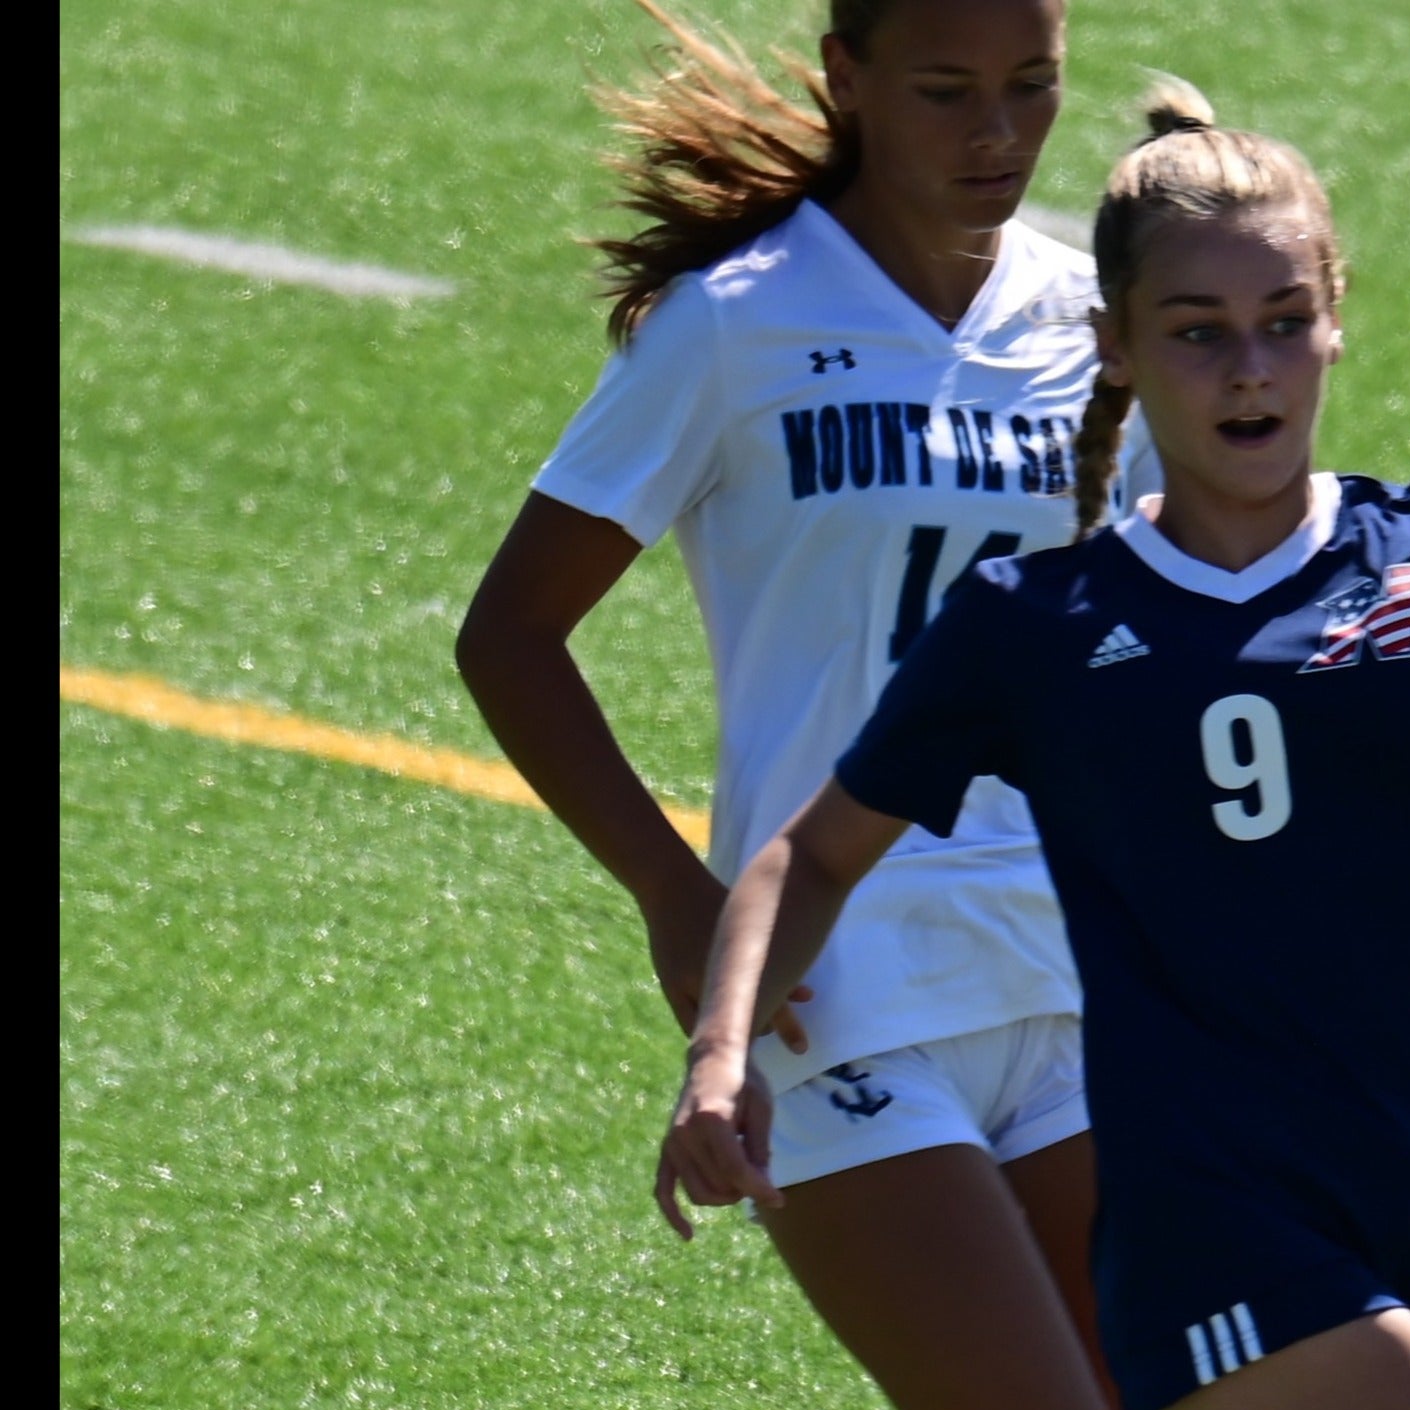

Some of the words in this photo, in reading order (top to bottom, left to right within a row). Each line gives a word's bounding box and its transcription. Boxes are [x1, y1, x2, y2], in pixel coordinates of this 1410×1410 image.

[781, 402, 932, 500] MOUNT
[947, 408, 1005, 492] DE
[889, 525, 1022, 663] 1
[1200, 693, 1292, 841] 9
